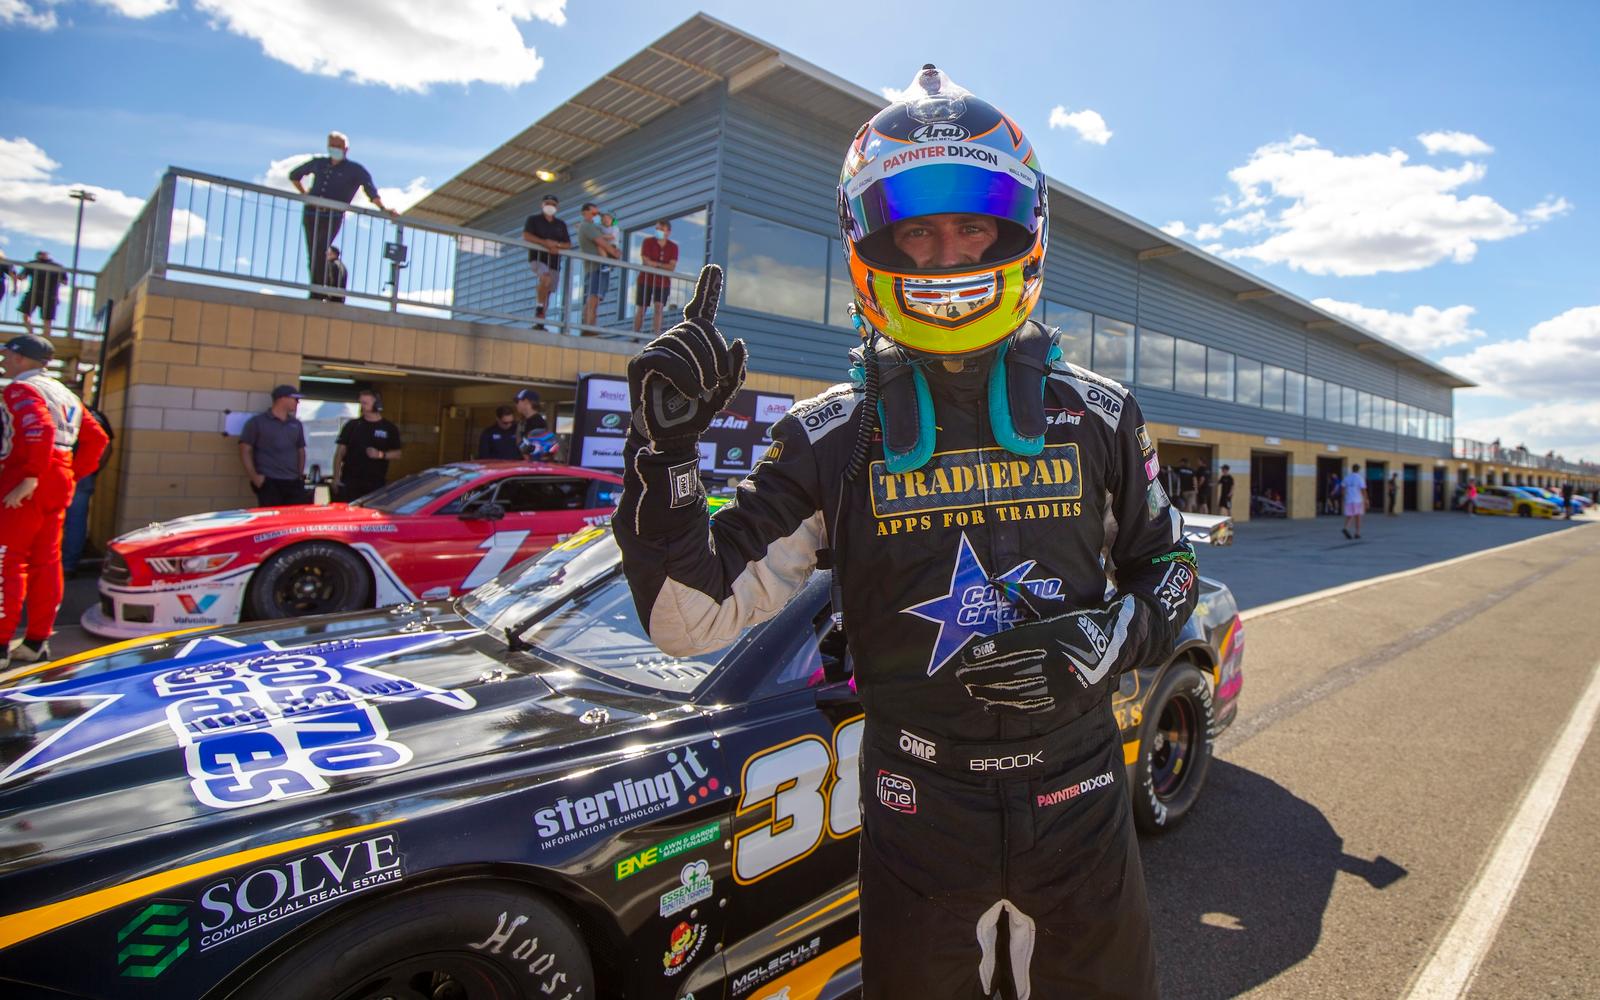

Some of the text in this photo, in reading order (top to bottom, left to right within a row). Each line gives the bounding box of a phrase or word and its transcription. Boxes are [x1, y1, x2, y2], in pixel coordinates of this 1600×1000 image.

[914, 124, 962, 139] Arai
[1087, 388, 1121, 414] OMP
[804, 402, 844, 428] OMP
[879, 458, 1074, 501] TRADIEPAD
[876, 501, 1082, 537] APPS FOR TRADIES
[459, 530, 531, 590] 1
[973, 642, 996, 657] OMP
[899, 734, 937, 759] OMP
[969, 750, 1045, 772] BROOK
[880, 774, 913, 791] race
[880, 785, 913, 805] line
[533, 769, 681, 838] sterling
[540, 801, 666, 850] INFORMATION TECHNOLOGY
[659, 839, 683, 854] LAWN
[662, 833, 715, 858] MAINTENANCE
[617, 846, 659, 881] BNE
[201, 834, 400, 932] SOLVE
[661, 877, 712, 906] ESSENTIAL
[201, 868, 403, 947] COMMERCIAL REAL ESTATE
[732, 936, 821, 991] MOLECULE
